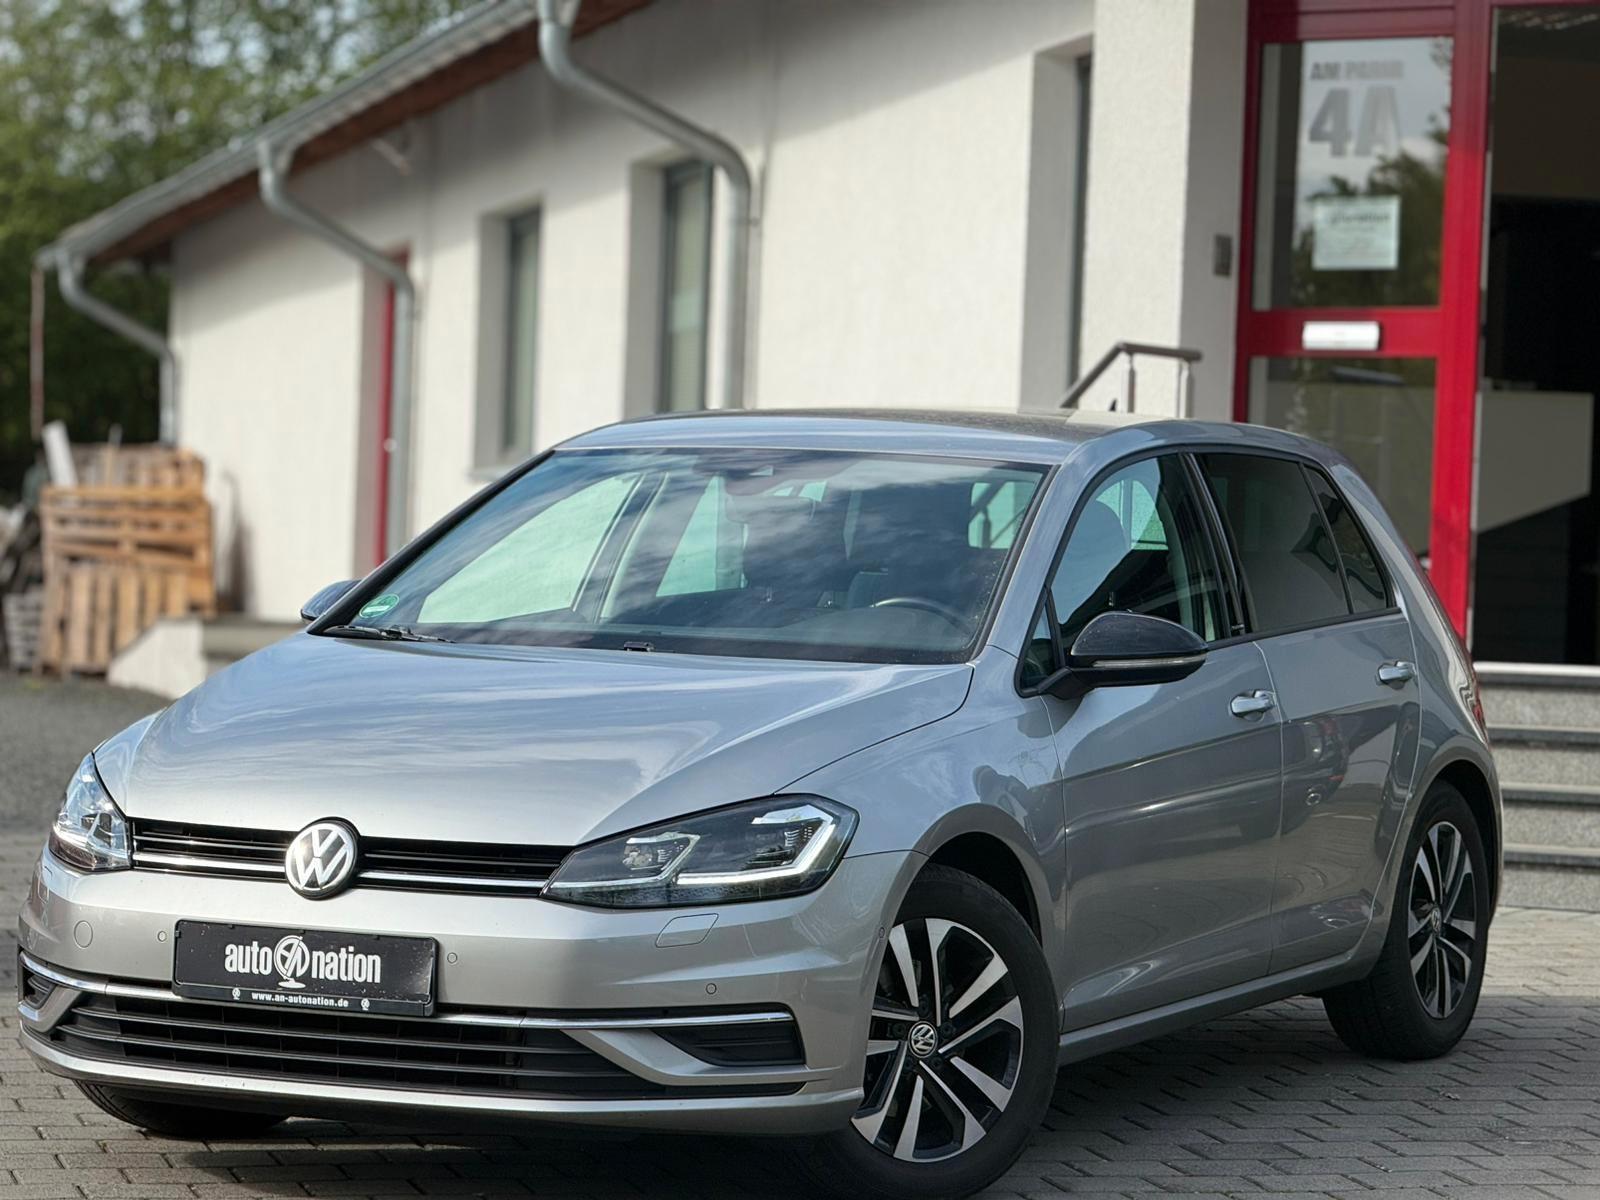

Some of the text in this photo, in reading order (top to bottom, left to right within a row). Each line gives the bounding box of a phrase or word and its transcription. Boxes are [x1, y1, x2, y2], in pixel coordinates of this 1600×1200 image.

[224, 940, 273, 976] auto
[311, 945, 381, 984] nation
[251, 991, 350, 1008] www.an-autonation.de
